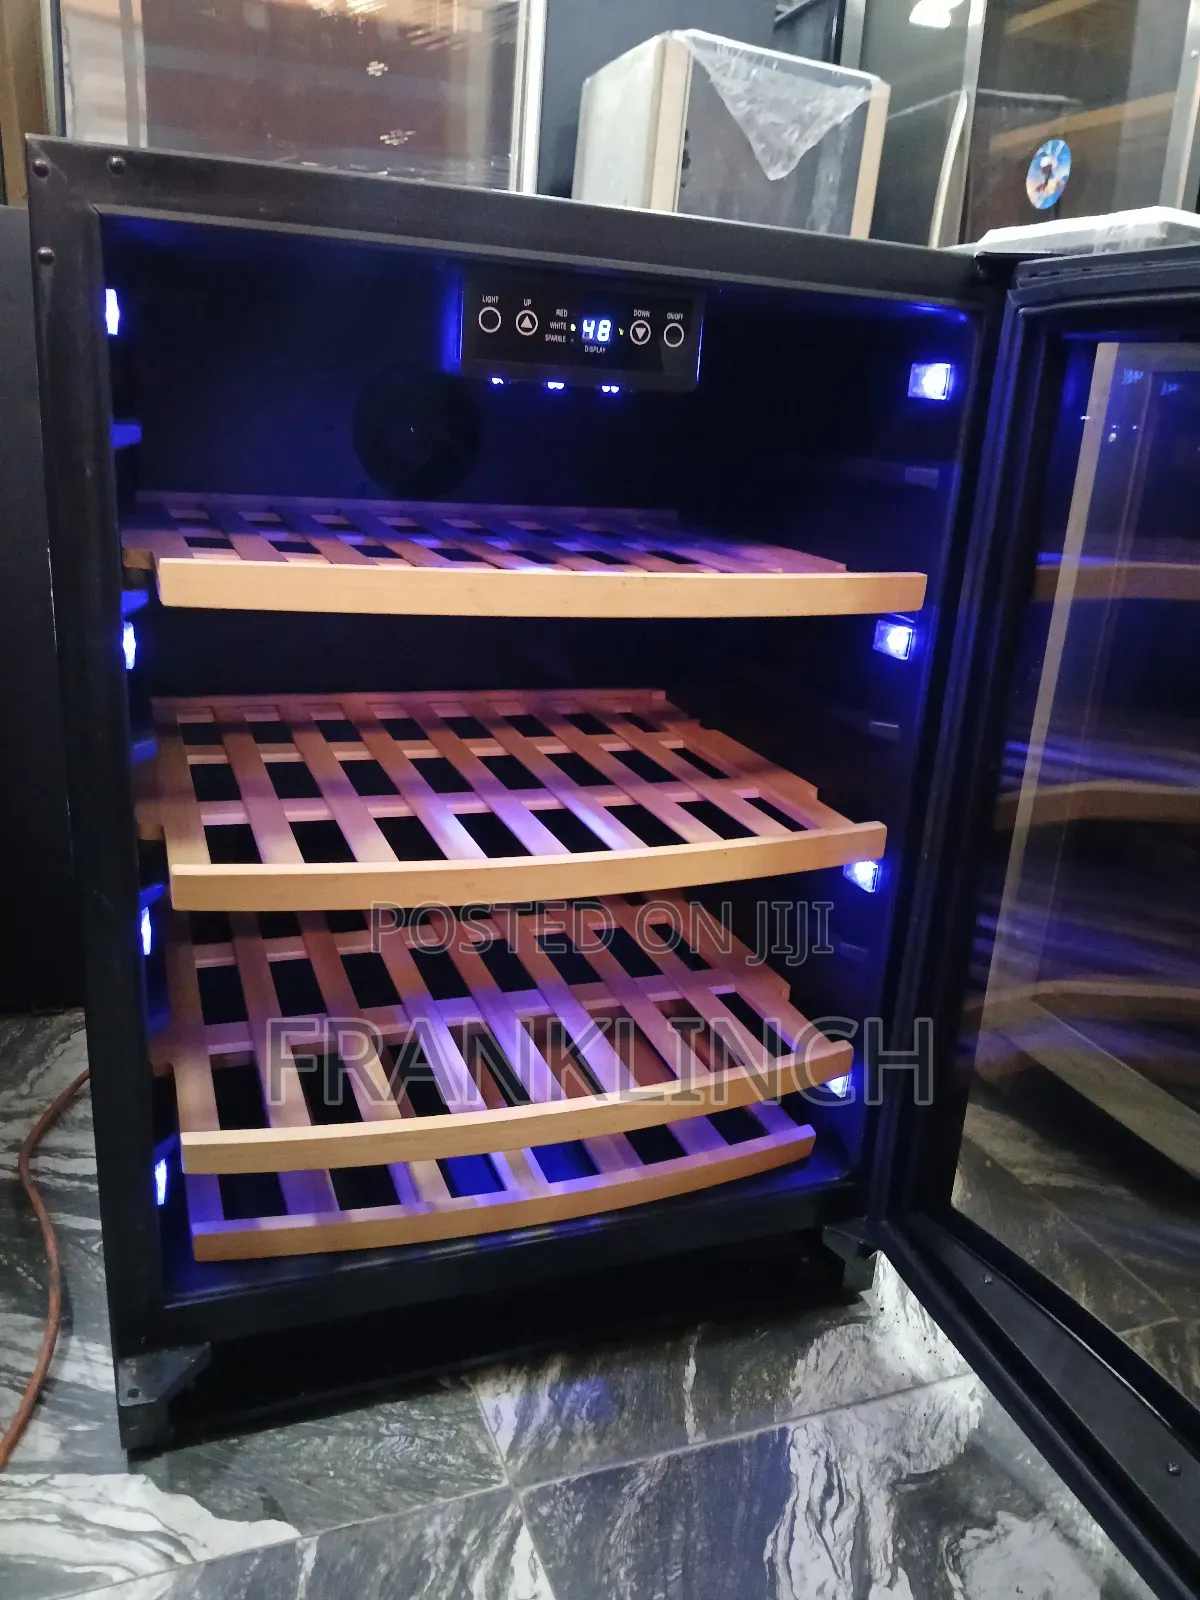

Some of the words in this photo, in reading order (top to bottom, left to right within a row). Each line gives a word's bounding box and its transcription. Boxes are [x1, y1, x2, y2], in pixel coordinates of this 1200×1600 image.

[482, 295, 499, 304] LIGHT
[523, 298, 532, 307] UP
[556, 308, 568, 317] RED
[633, 309, 651, 318] DOWN
[549, 321, 567, 331] WHITE
[582, 319, 611, 341] 48
[584, 345, 606, 354] DISPLAY
